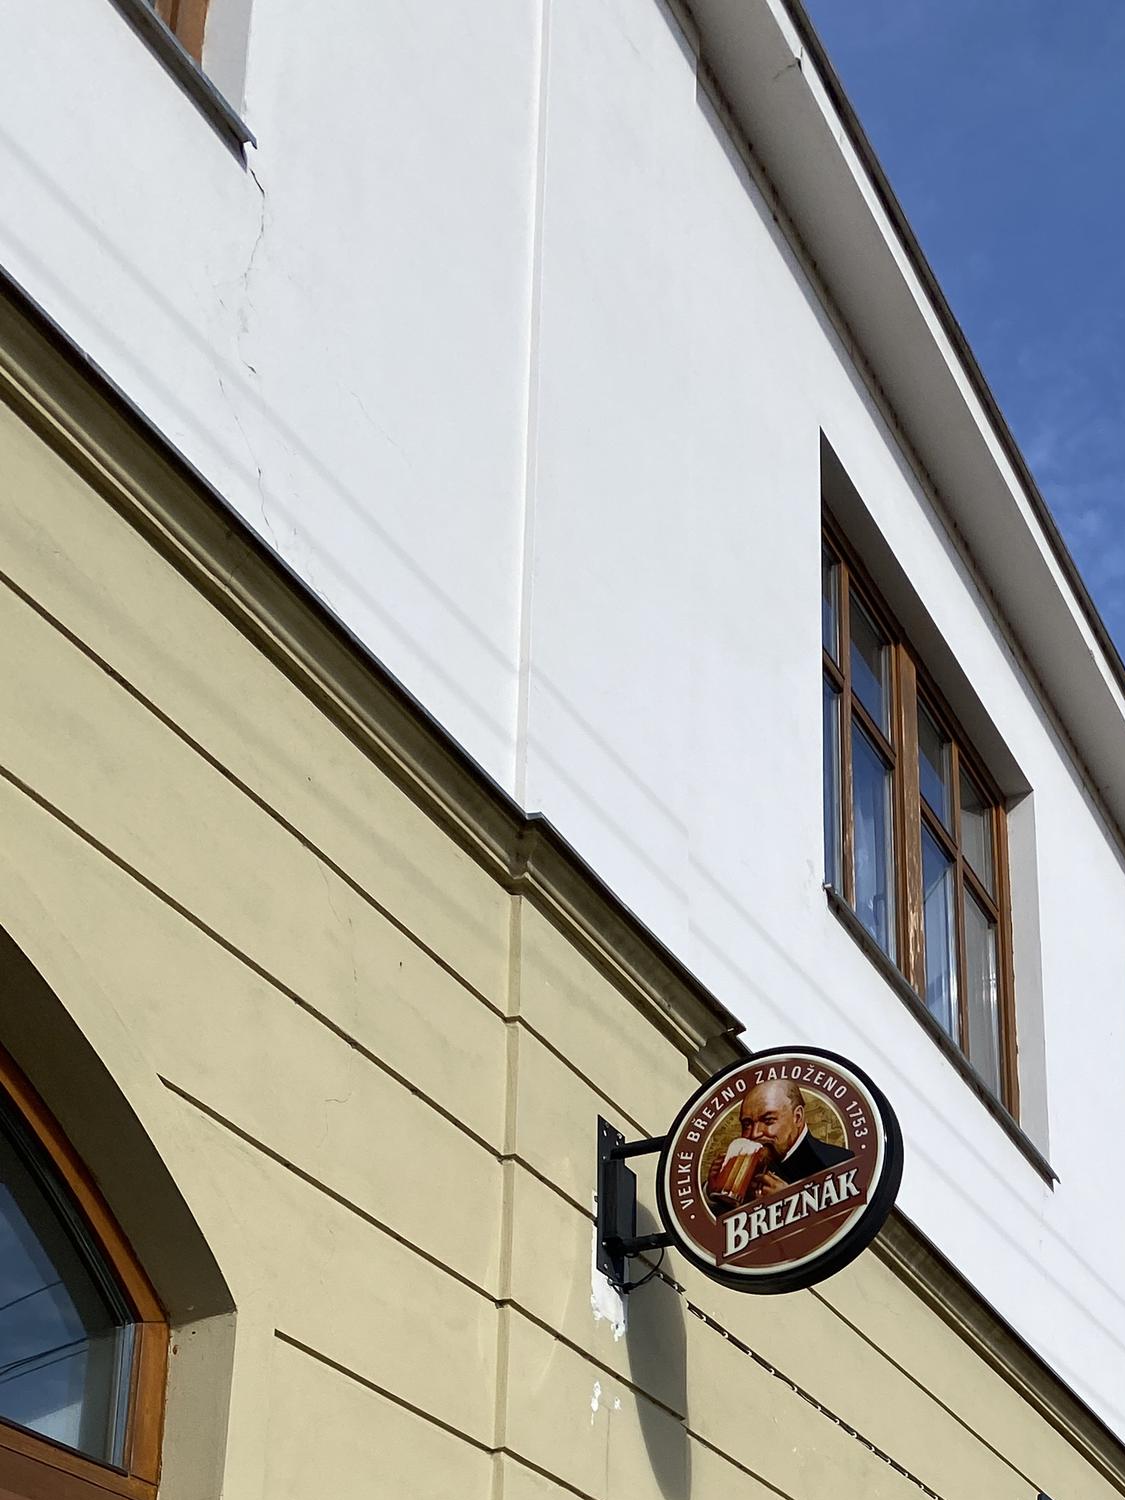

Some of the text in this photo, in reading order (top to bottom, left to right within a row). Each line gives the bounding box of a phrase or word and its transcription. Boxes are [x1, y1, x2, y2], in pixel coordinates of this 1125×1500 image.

[677, 1064, 869, 1210] VELKÉ BŘEZNO ZALOŽENO 1753
[723, 1168, 861, 1258] BŘEZŇÁK
